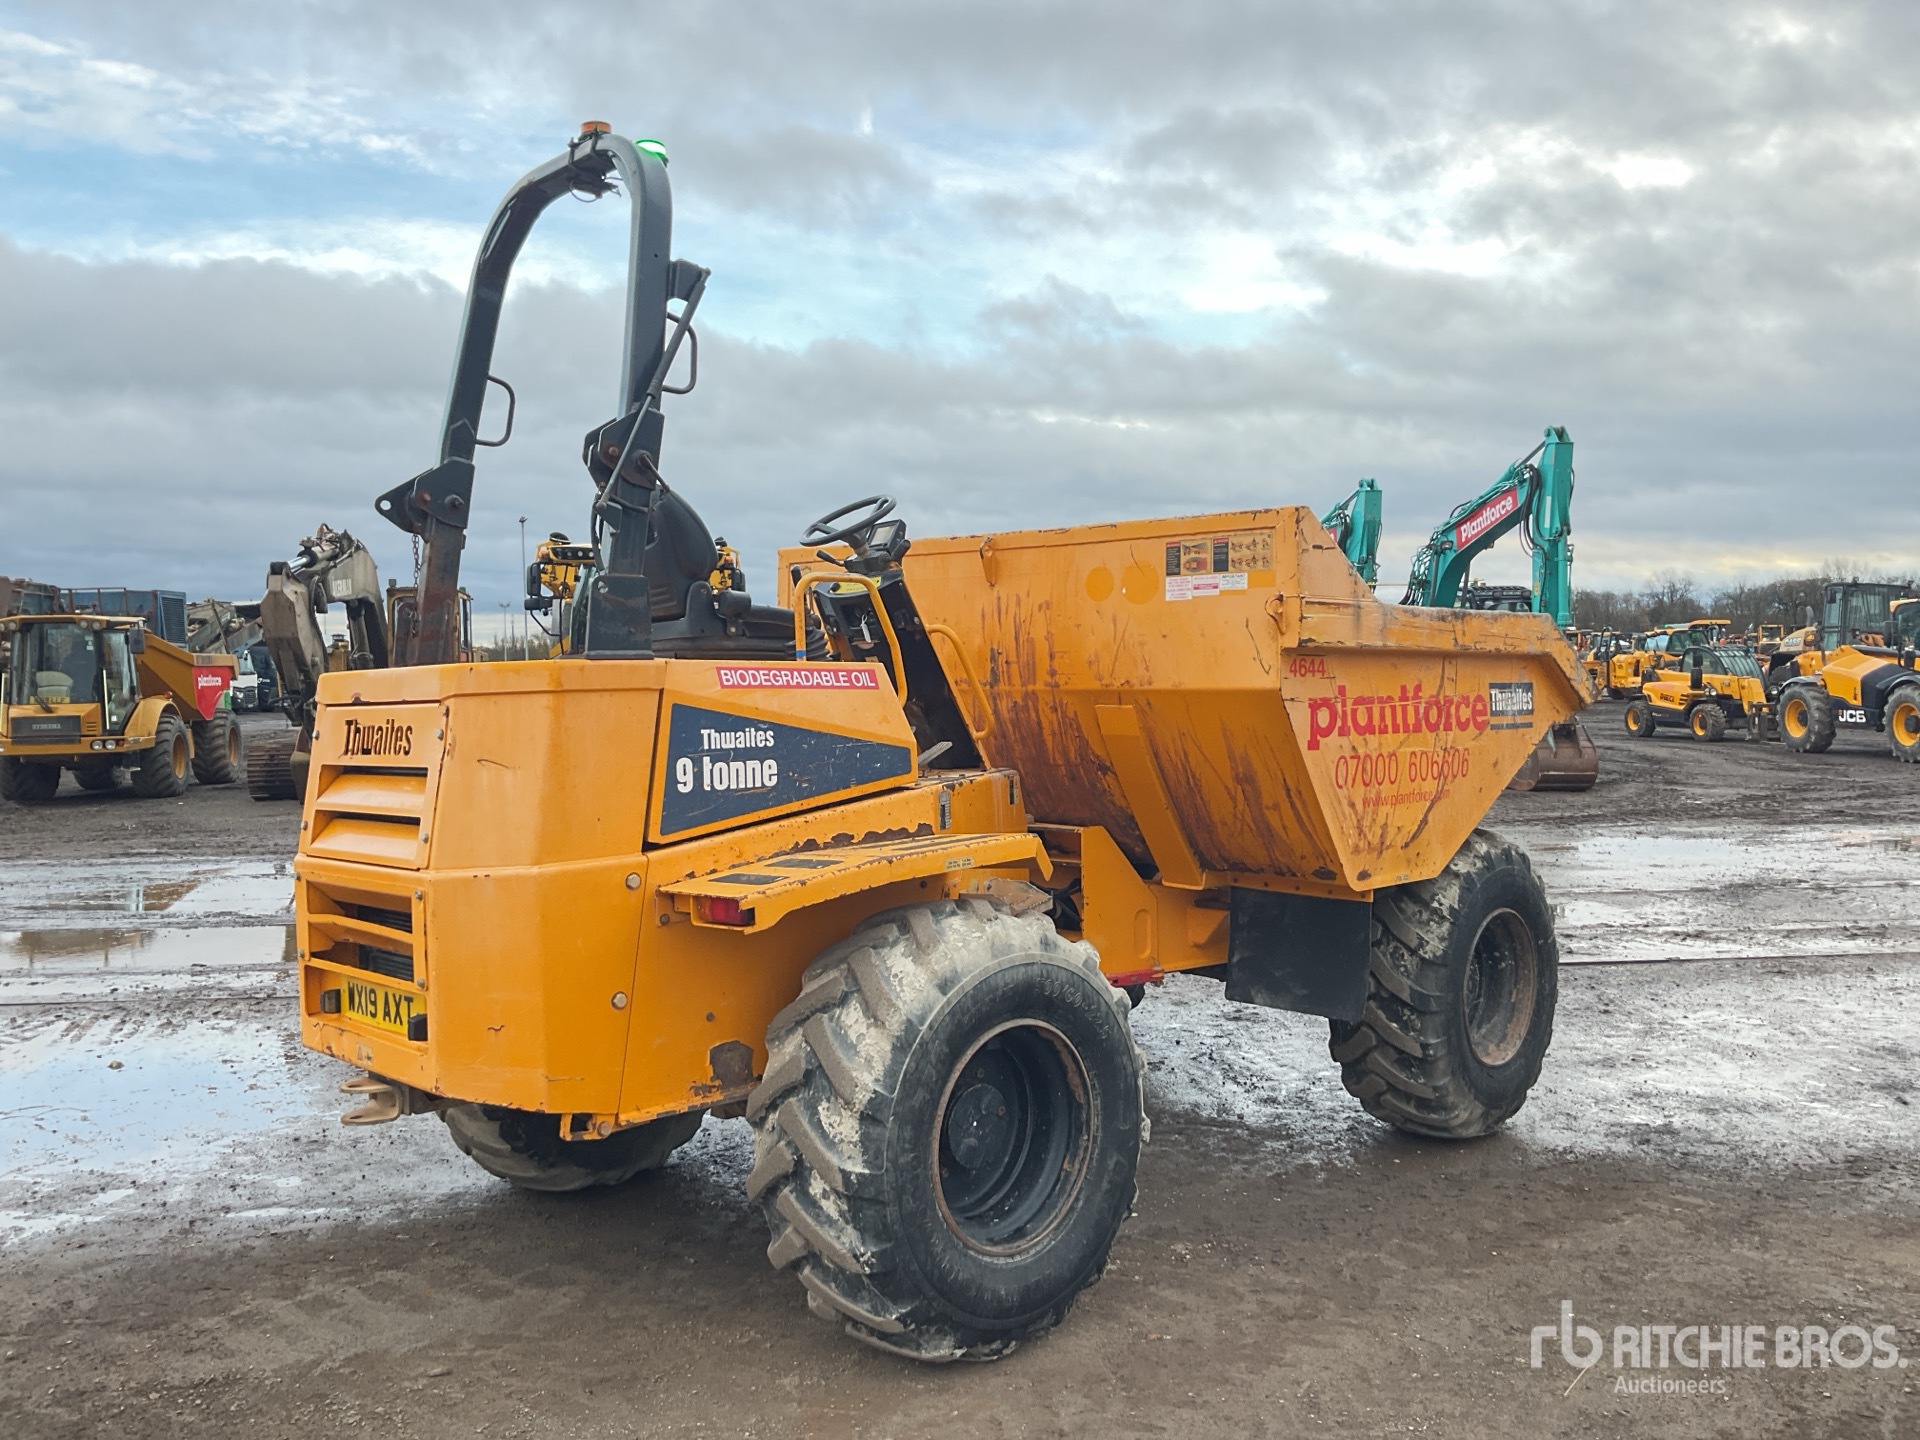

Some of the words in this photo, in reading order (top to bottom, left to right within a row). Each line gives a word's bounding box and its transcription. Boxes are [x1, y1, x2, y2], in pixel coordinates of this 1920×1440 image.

[720, 669, 850, 686] BIODEGRADABLE
[851, 671, 876, 687] OIL
[1289, 657, 1327, 677] 4644
[1490, 688, 1533, 712] Thwaites
[1307, 683, 1490, 750] plantforce
[1838, 709, 1866, 723] JCB
[343, 718, 413, 756] Thwaites
[700, 727, 775, 750] Thwaites
[676, 756, 694, 794] 9
[702, 755, 778, 791] tonne
[1335, 750, 1399, 789] 07000
[1408, 747, 1470, 783] 606606
[1362, 787, 1451, 809] www.plantforcem
[347, 981, 378, 1019] WX19
[383, 991, 414, 1026] AXT
